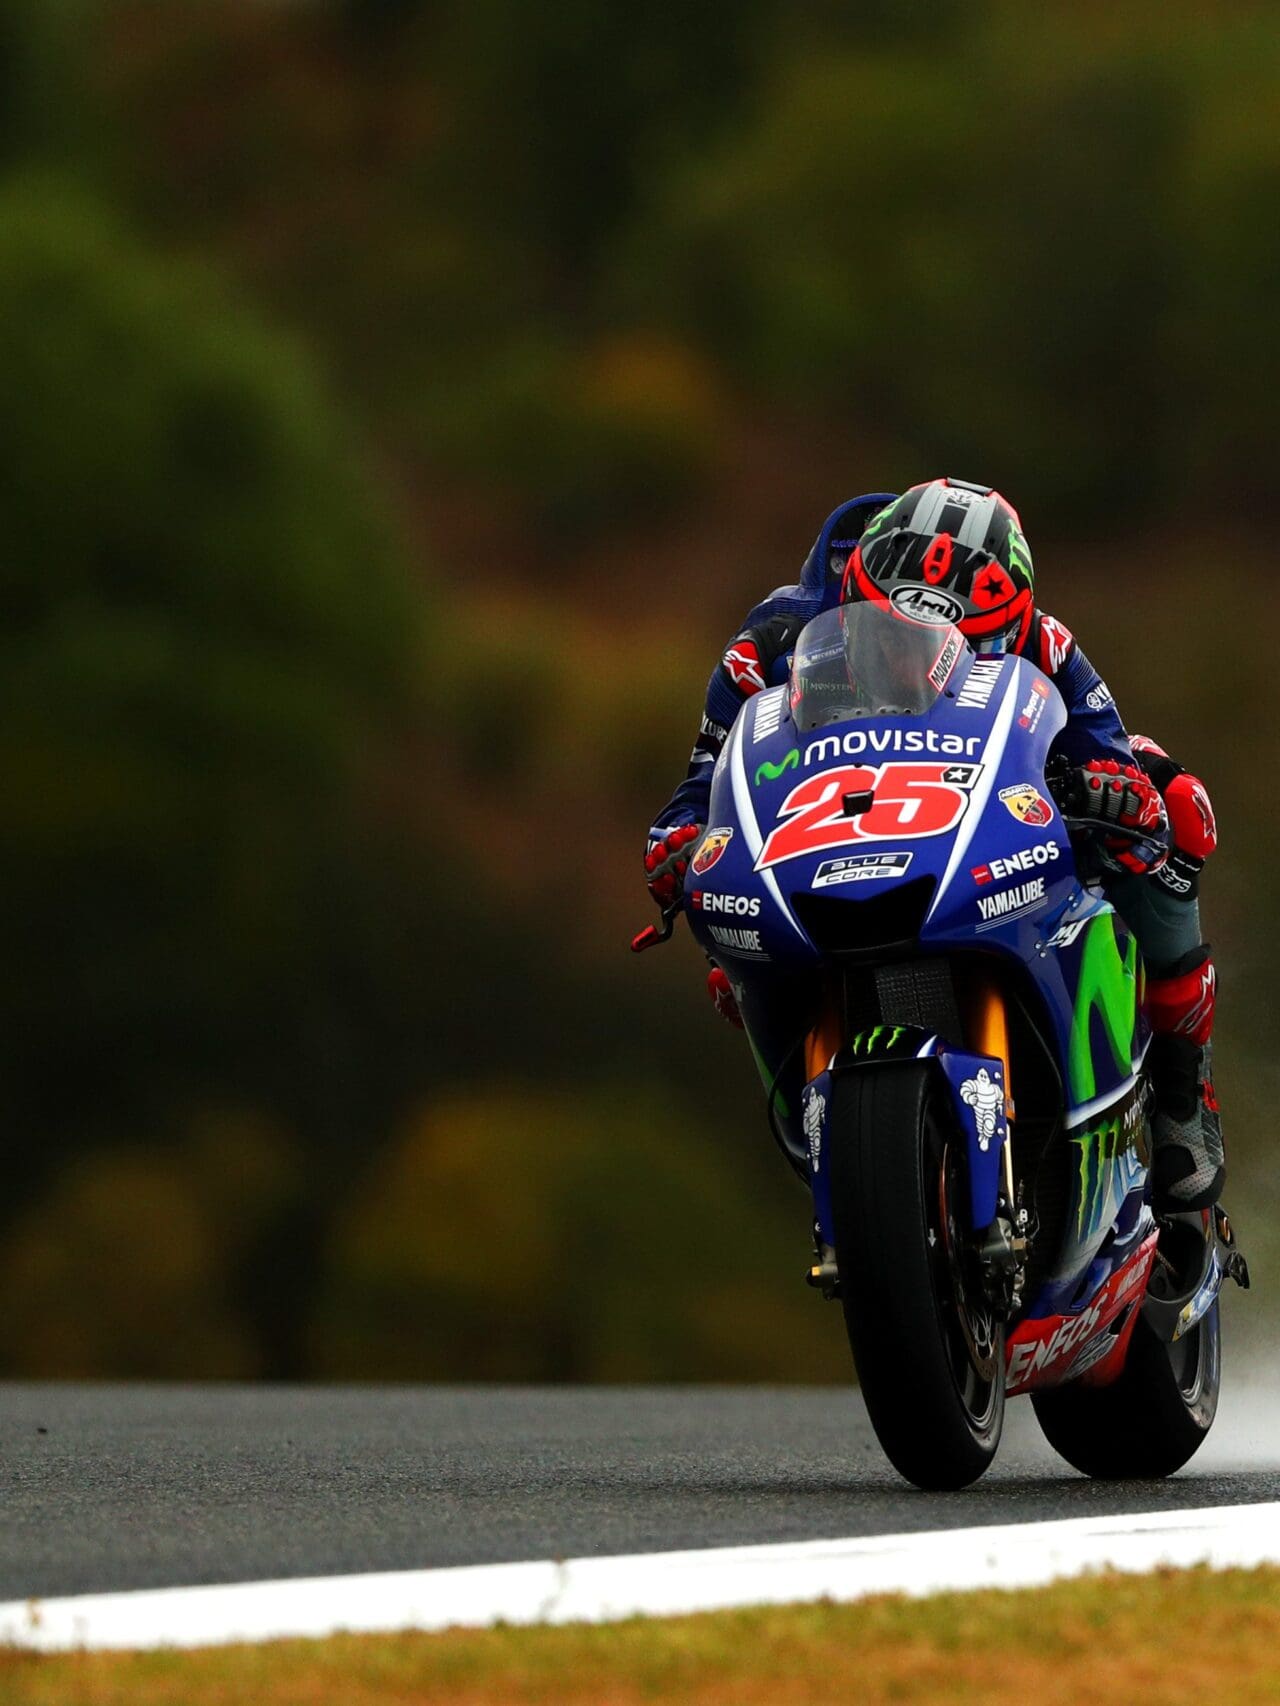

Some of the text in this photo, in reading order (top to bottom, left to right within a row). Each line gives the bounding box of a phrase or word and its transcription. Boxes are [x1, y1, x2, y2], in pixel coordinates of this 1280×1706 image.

[895, 591, 956, 619] Arai
[956, 659, 1005, 709] YAMAHA
[804, 730, 982, 766] movistar
[753, 761, 978, 872] 25
[826, 867, 892, 884] CORE
[830, 855, 899, 869] BLUE
[989, 841, 1060, 880] ENEOS
[702, 892, 761, 917] ENEOS
[977, 877, 1046, 920] YAMALUBE
[708, 924, 763, 951] YAMALUBE
[1005, 1292, 1108, 1391] ENEOS
